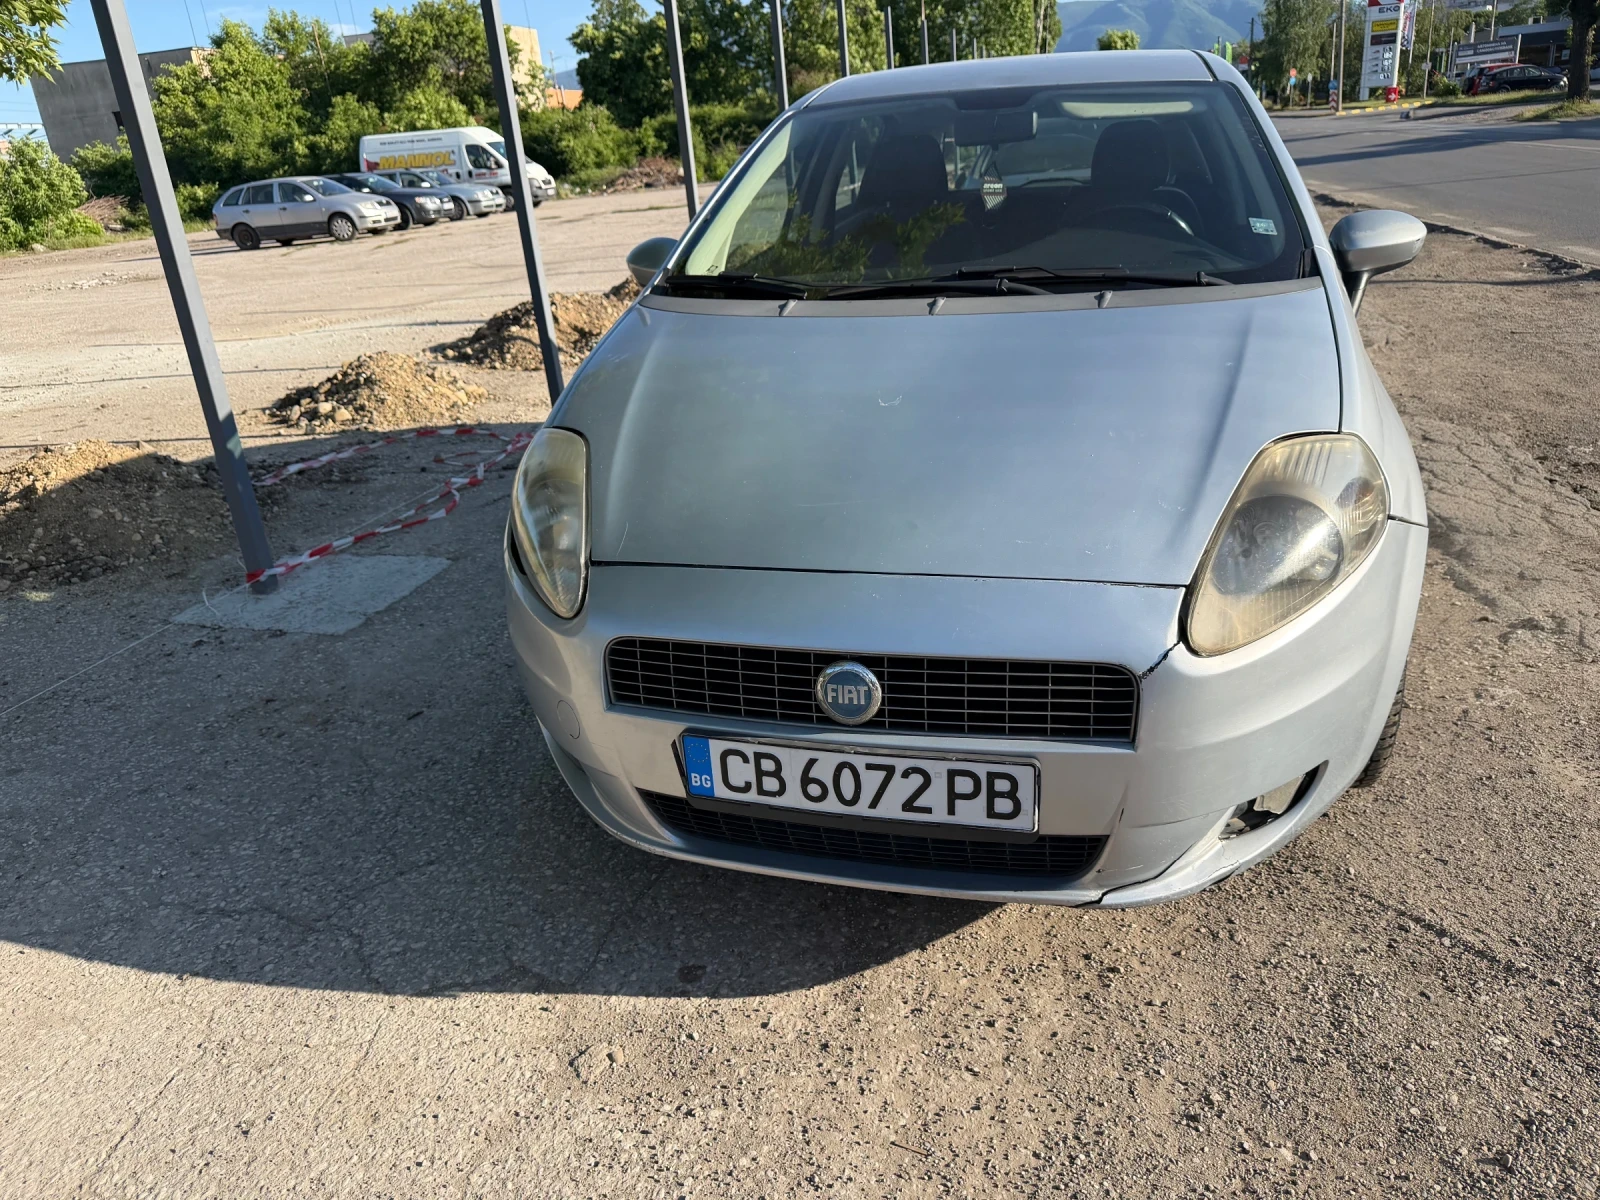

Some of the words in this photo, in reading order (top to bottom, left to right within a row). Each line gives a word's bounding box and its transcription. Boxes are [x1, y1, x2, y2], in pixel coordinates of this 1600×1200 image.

[1378, 5, 1401, 14] EKO
[378, 151, 454, 169] MANNOL
[826, 683, 869, 705] FIAT
[691, 772, 711, 789] BG
[719, 748, 787, 798] CB
[799, 757, 933, 815] 6072
[946, 768, 1022, 820] PB
